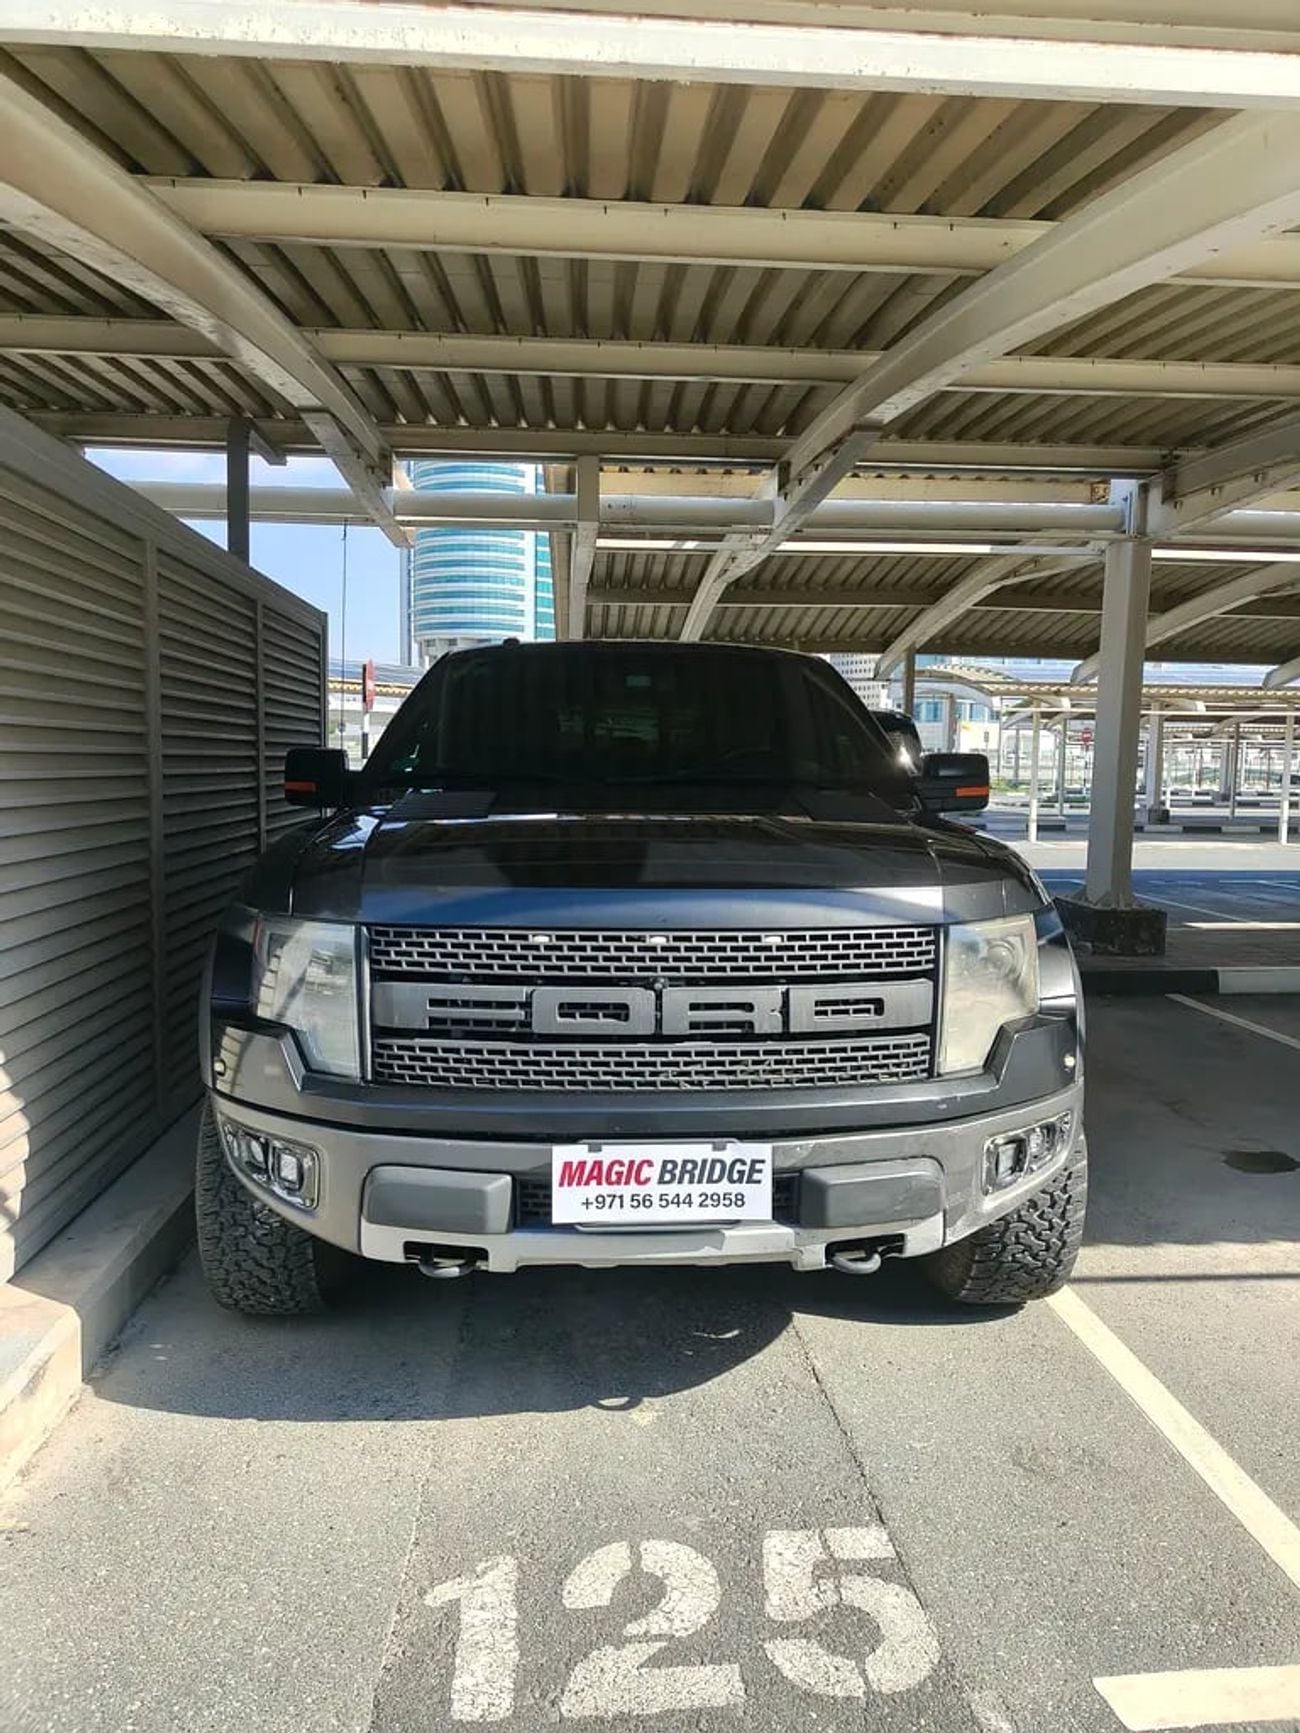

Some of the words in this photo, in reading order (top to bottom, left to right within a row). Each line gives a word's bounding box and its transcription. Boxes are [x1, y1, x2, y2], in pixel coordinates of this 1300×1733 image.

[371, 979, 933, 1035] FORD
[558, 1159, 655, 1187] MAGIC
[657, 1158, 766, 1185] BRIDGE
[581, 1193, 624, 1210] +971
[630, 1193, 653, 1208] 56
[658, 1193, 694, 1208] 544
[699, 1192, 746, 1208] 2958
[423, 1526, 942, 1722] 125
